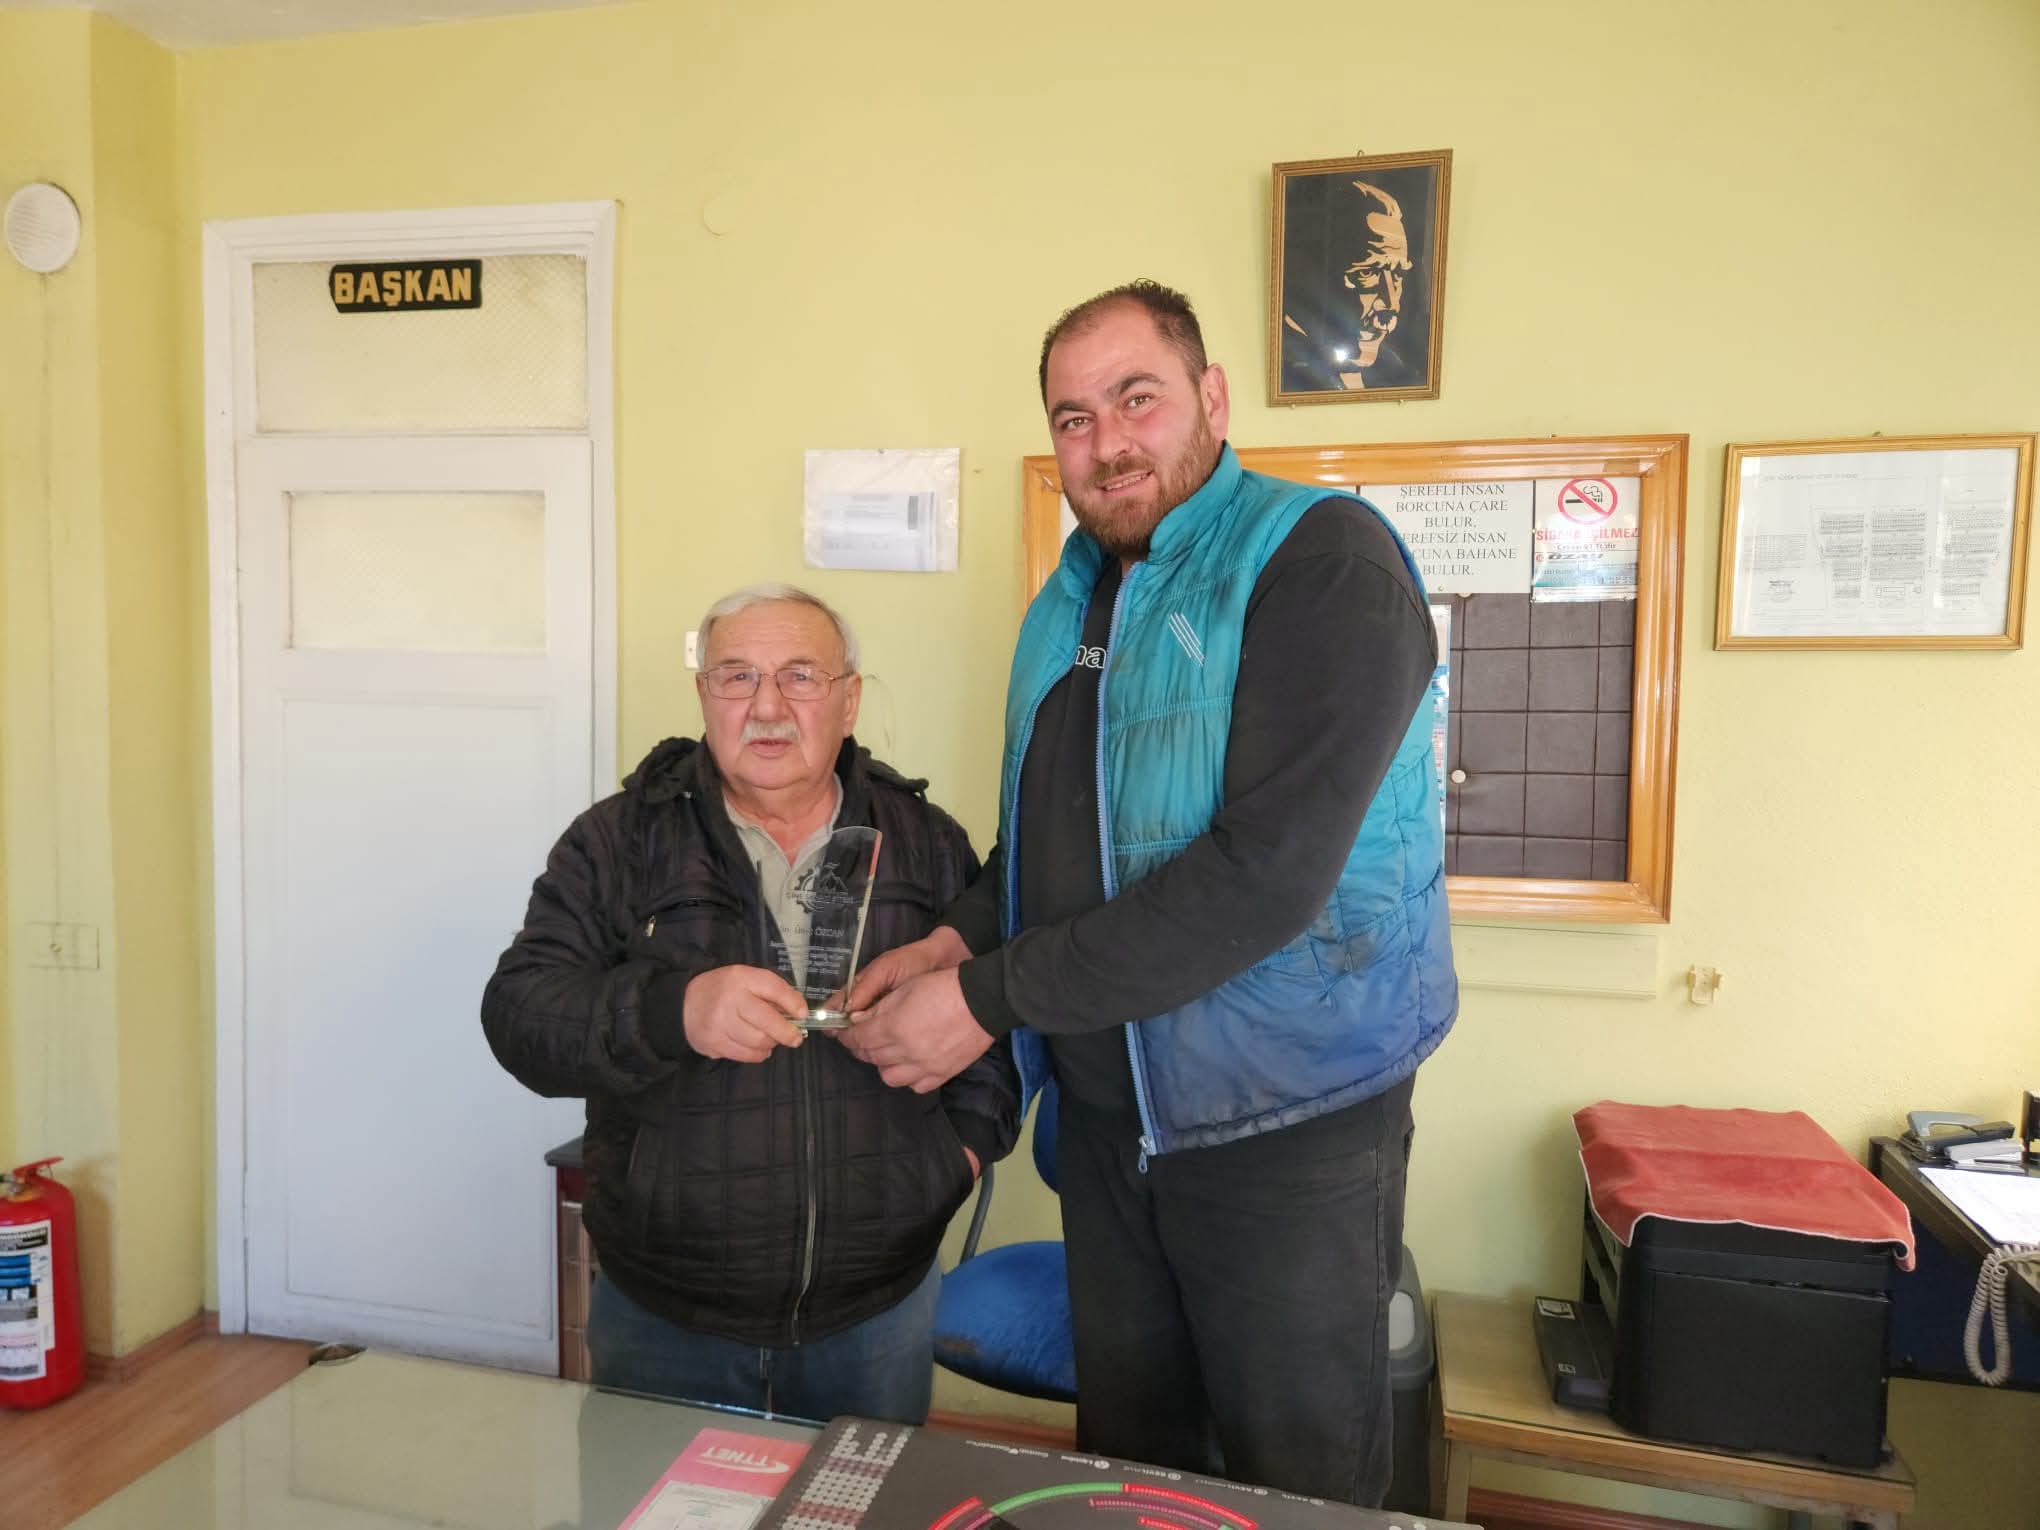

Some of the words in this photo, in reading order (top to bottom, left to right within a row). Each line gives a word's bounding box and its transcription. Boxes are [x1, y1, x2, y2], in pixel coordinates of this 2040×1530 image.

[334, 267, 472, 307] BAŞKAN
[1461, 482, 1505, 497] İNSAN
[1396, 501, 1465, 513] BORCUNA
[1469, 500, 1509, 514] ÇARE
[1425, 516, 1477, 528] BULUR.
[1402, 530, 1458, 544] EREFSİZ
[1463, 530, 1506, 544] İNSAN
[1456, 548, 1517, 560] BAHANE
[1422, 564, 1475, 576] BULUR.
[702, 1447, 768, 1467] TTNET
